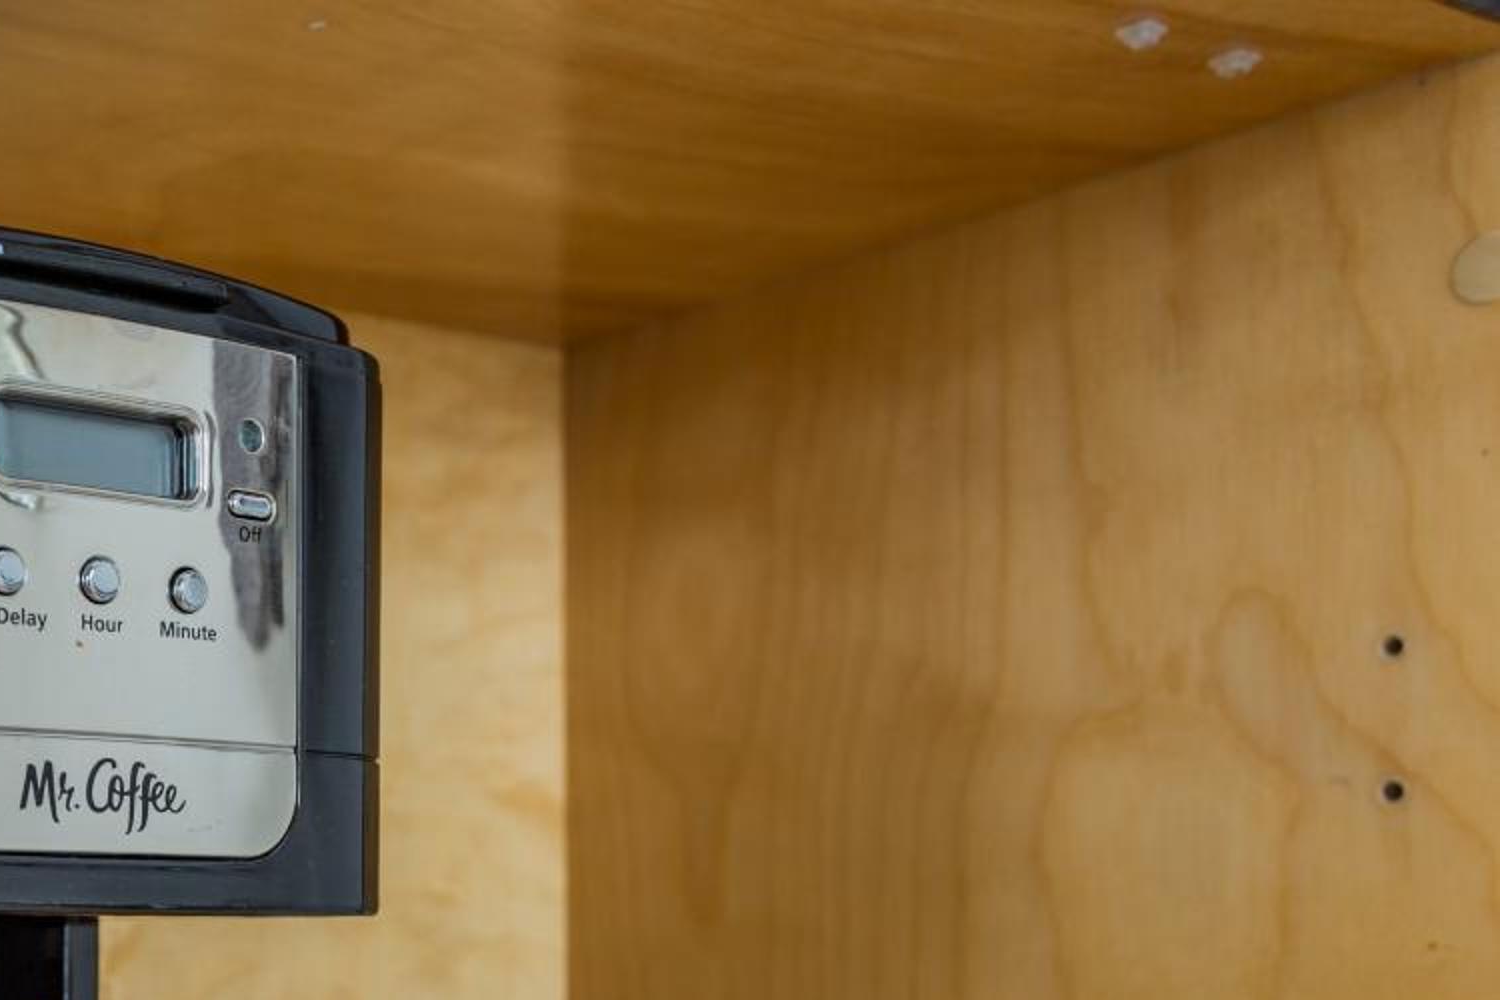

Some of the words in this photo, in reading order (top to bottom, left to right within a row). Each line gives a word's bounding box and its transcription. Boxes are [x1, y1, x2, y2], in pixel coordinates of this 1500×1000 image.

[239, 525, 262, 544] Off
[81, 614, 123, 633] Hour
[159, 621, 217, 642] Minute
[19, 759, 80, 824] Mr.
[85, 757, 187, 835] Coffee
